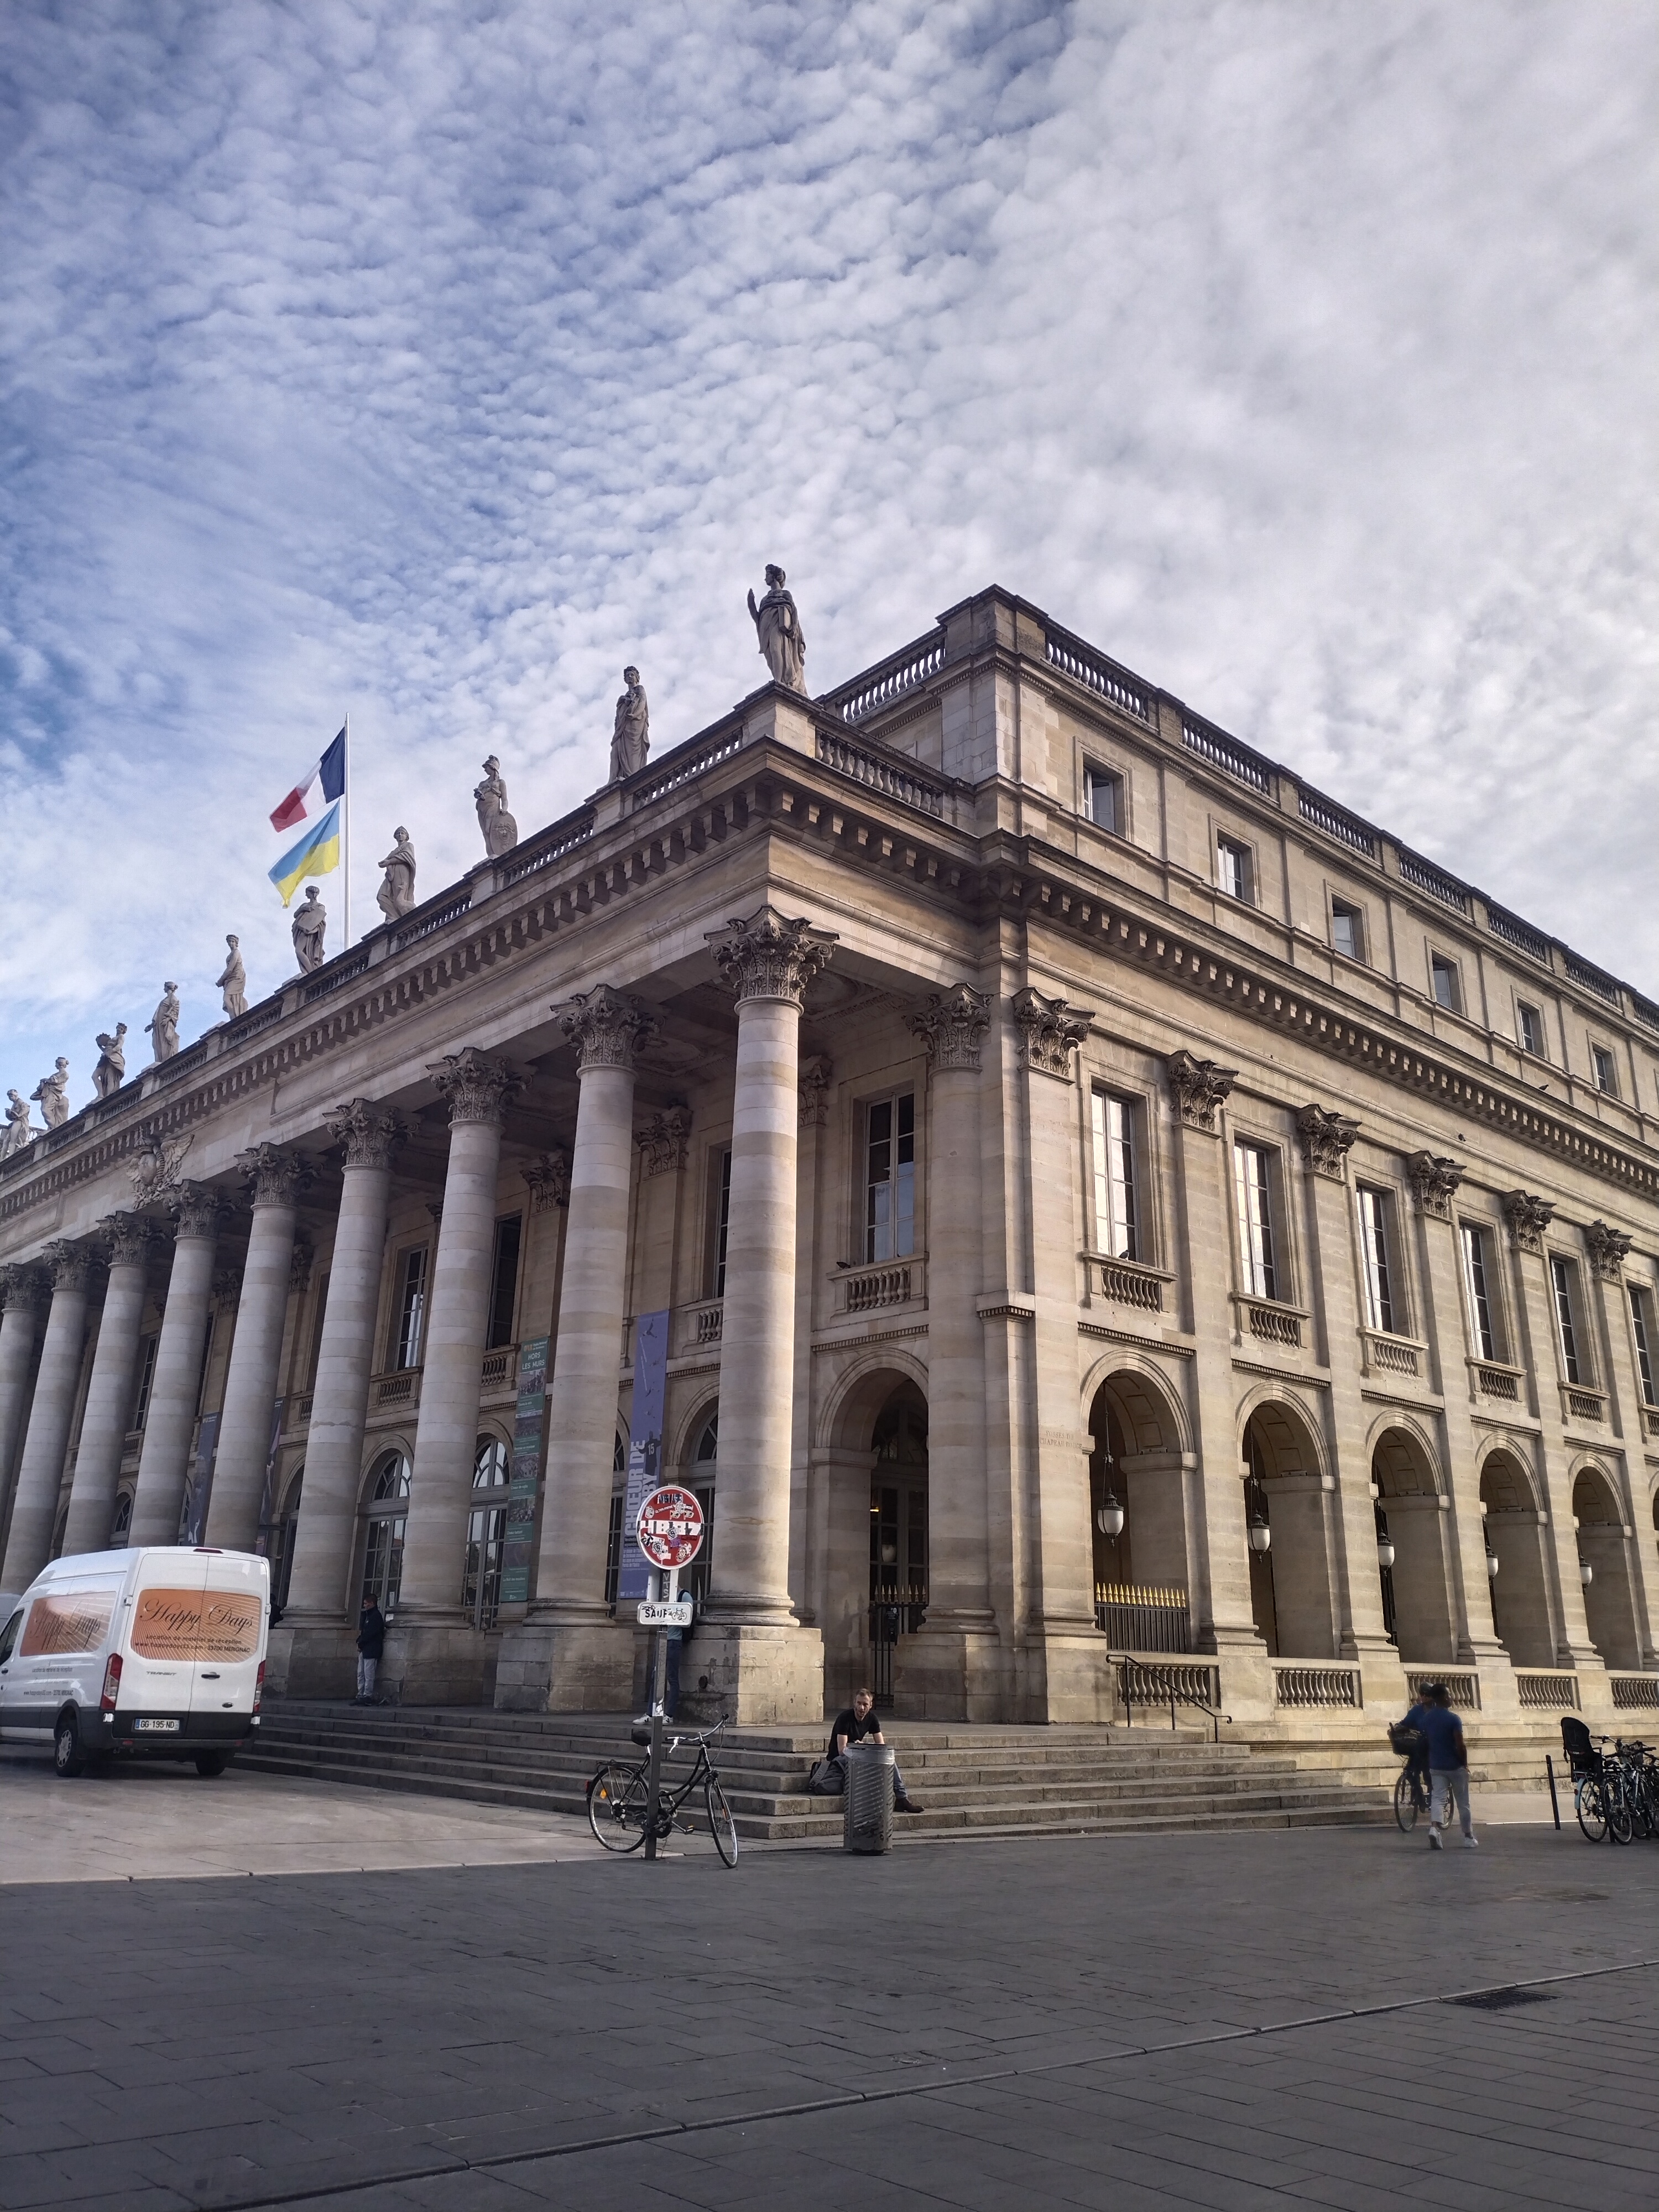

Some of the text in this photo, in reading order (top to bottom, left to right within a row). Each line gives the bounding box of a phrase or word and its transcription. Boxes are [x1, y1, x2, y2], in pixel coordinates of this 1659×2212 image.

[528, 1352, 541, 1360] HORS
[532, 1359, 545, 1368] MURS
[1067, 1432, 1074, 1440] DU
[1039, 1438, 1065, 1447] CHAPEAU
[629, 1440, 646, 1464] DE
[648, 1443, 655, 1455] 15
[139, 1598, 253, 1636] Happy Days
[645, 1608, 667, 1618] SAUF
